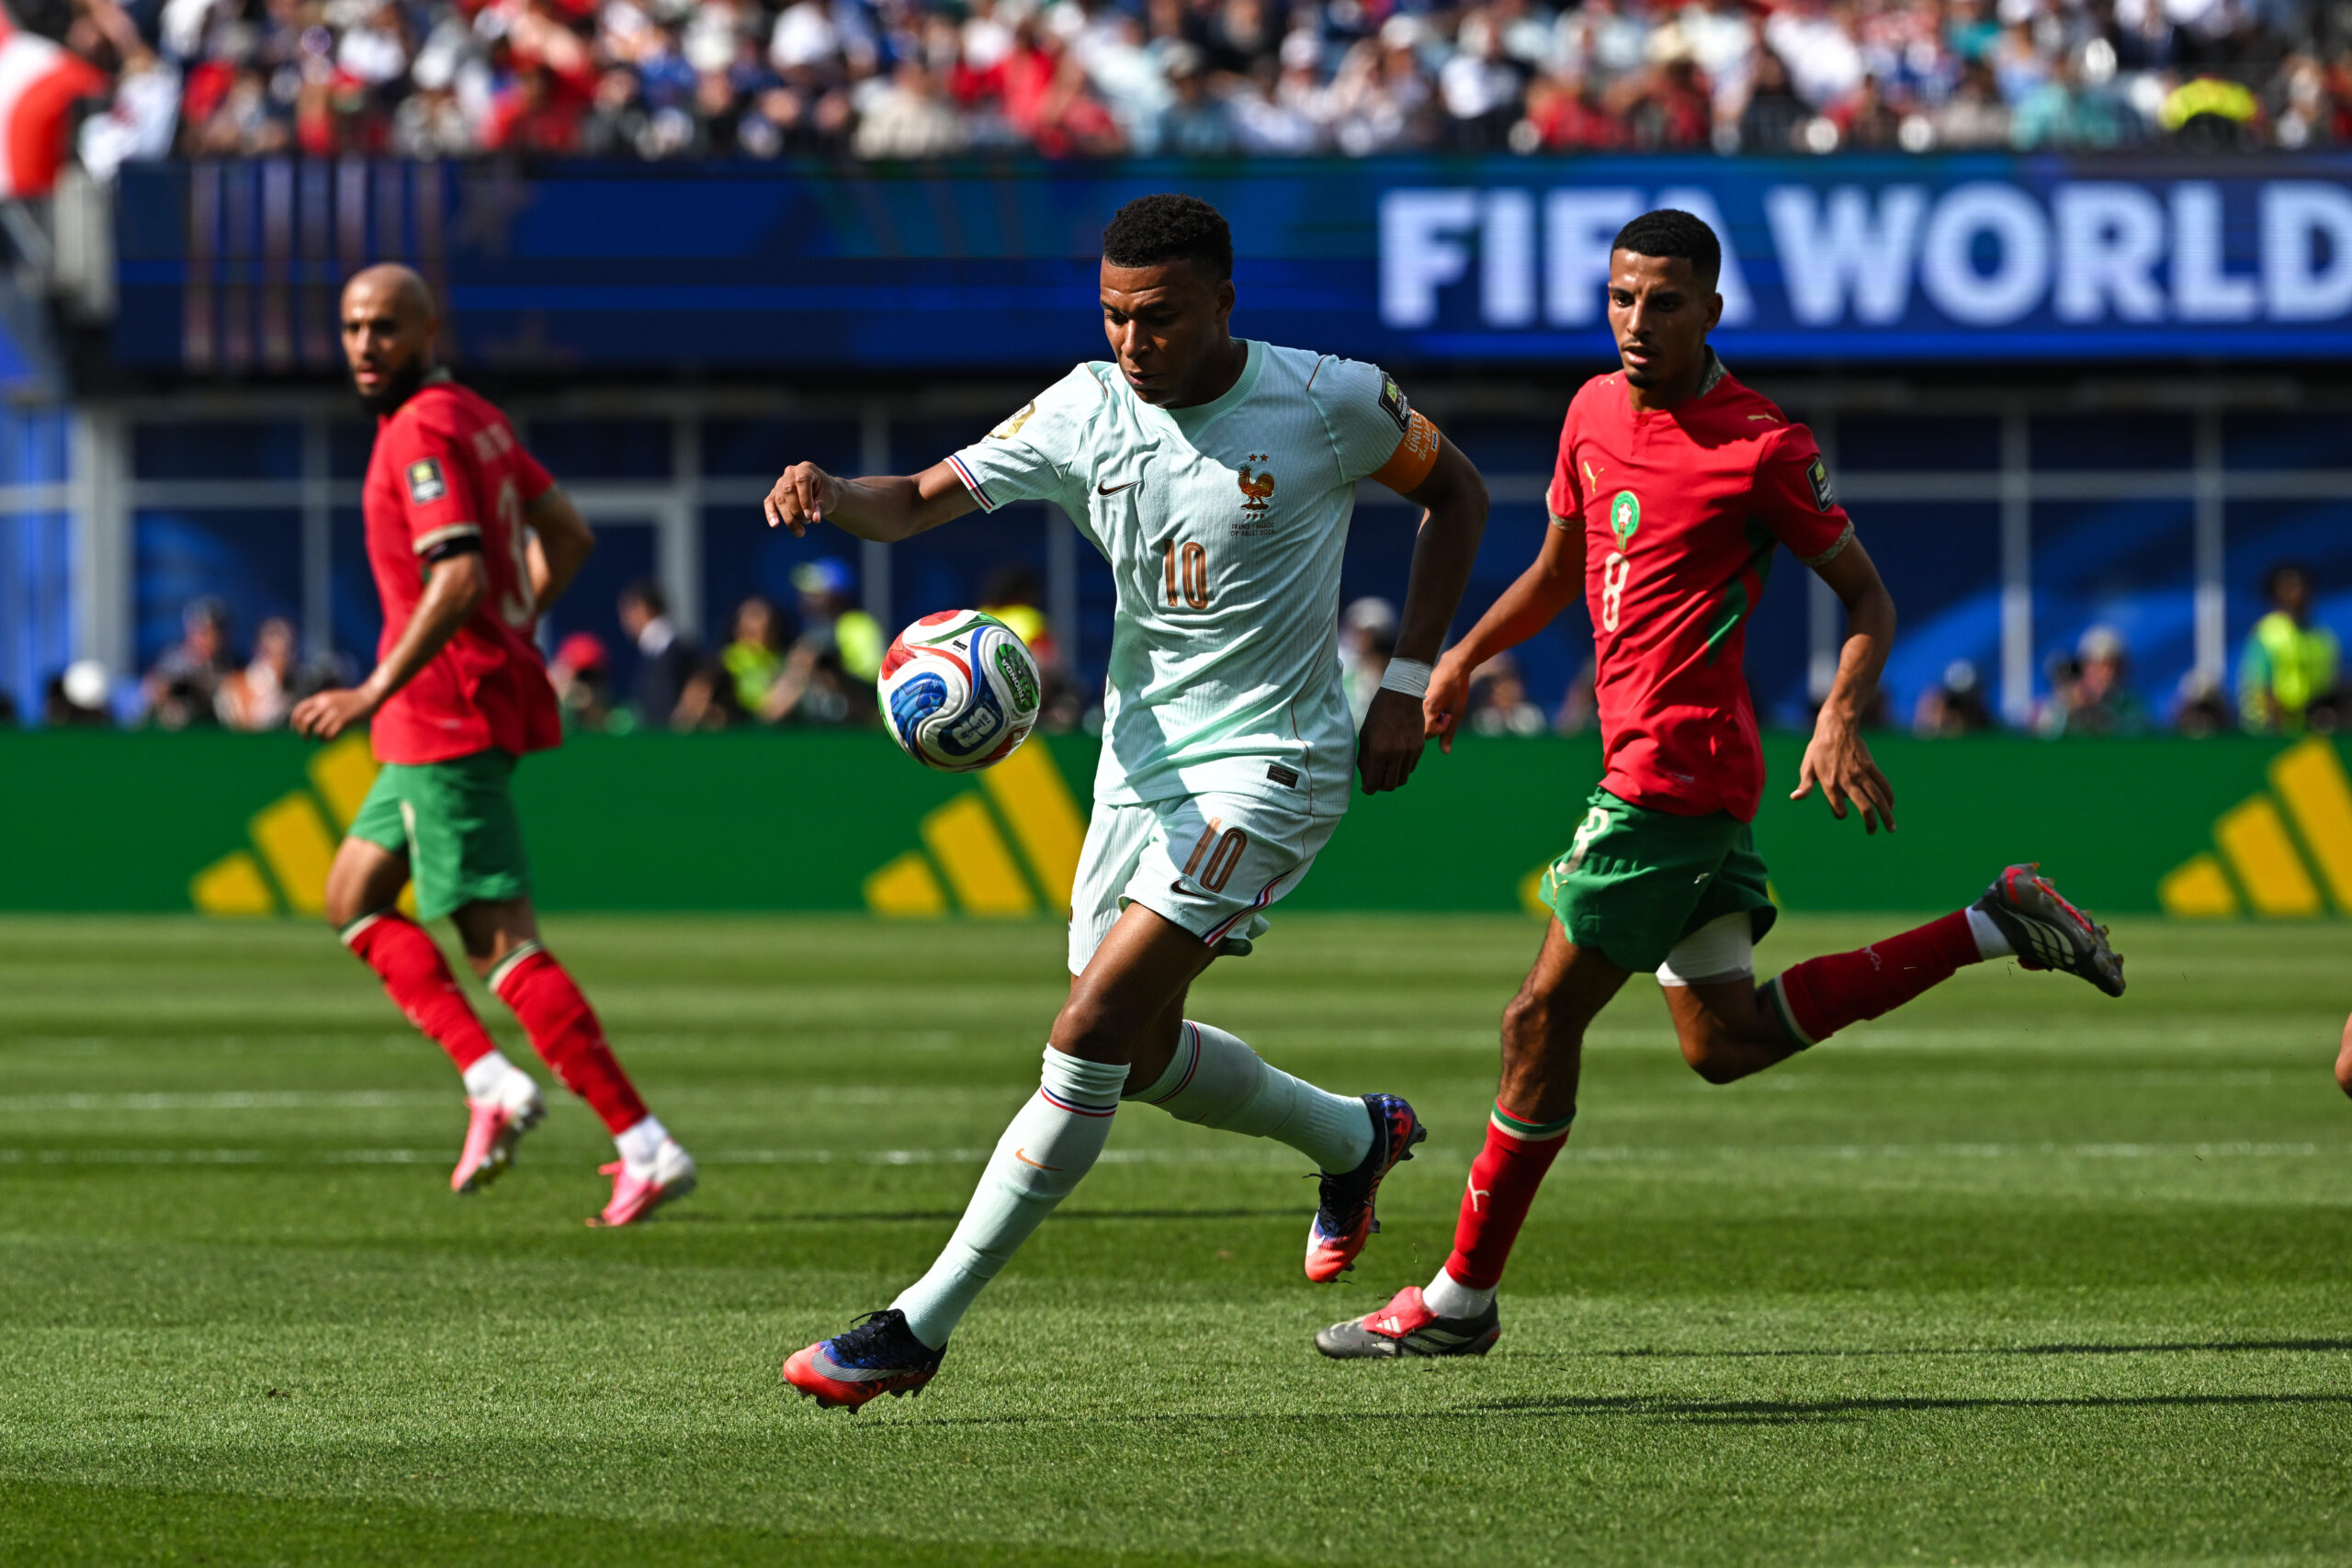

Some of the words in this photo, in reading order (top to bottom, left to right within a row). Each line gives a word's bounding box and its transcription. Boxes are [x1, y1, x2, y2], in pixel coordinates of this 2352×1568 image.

[1765, 182, 2352, 328] WORLD
[1164, 539, 1208, 610] 10
[1602, 552, 1631, 632] 8
[1001, 658, 1025, 705] TRIONDA
[1182, 817, 1248, 895] 10
